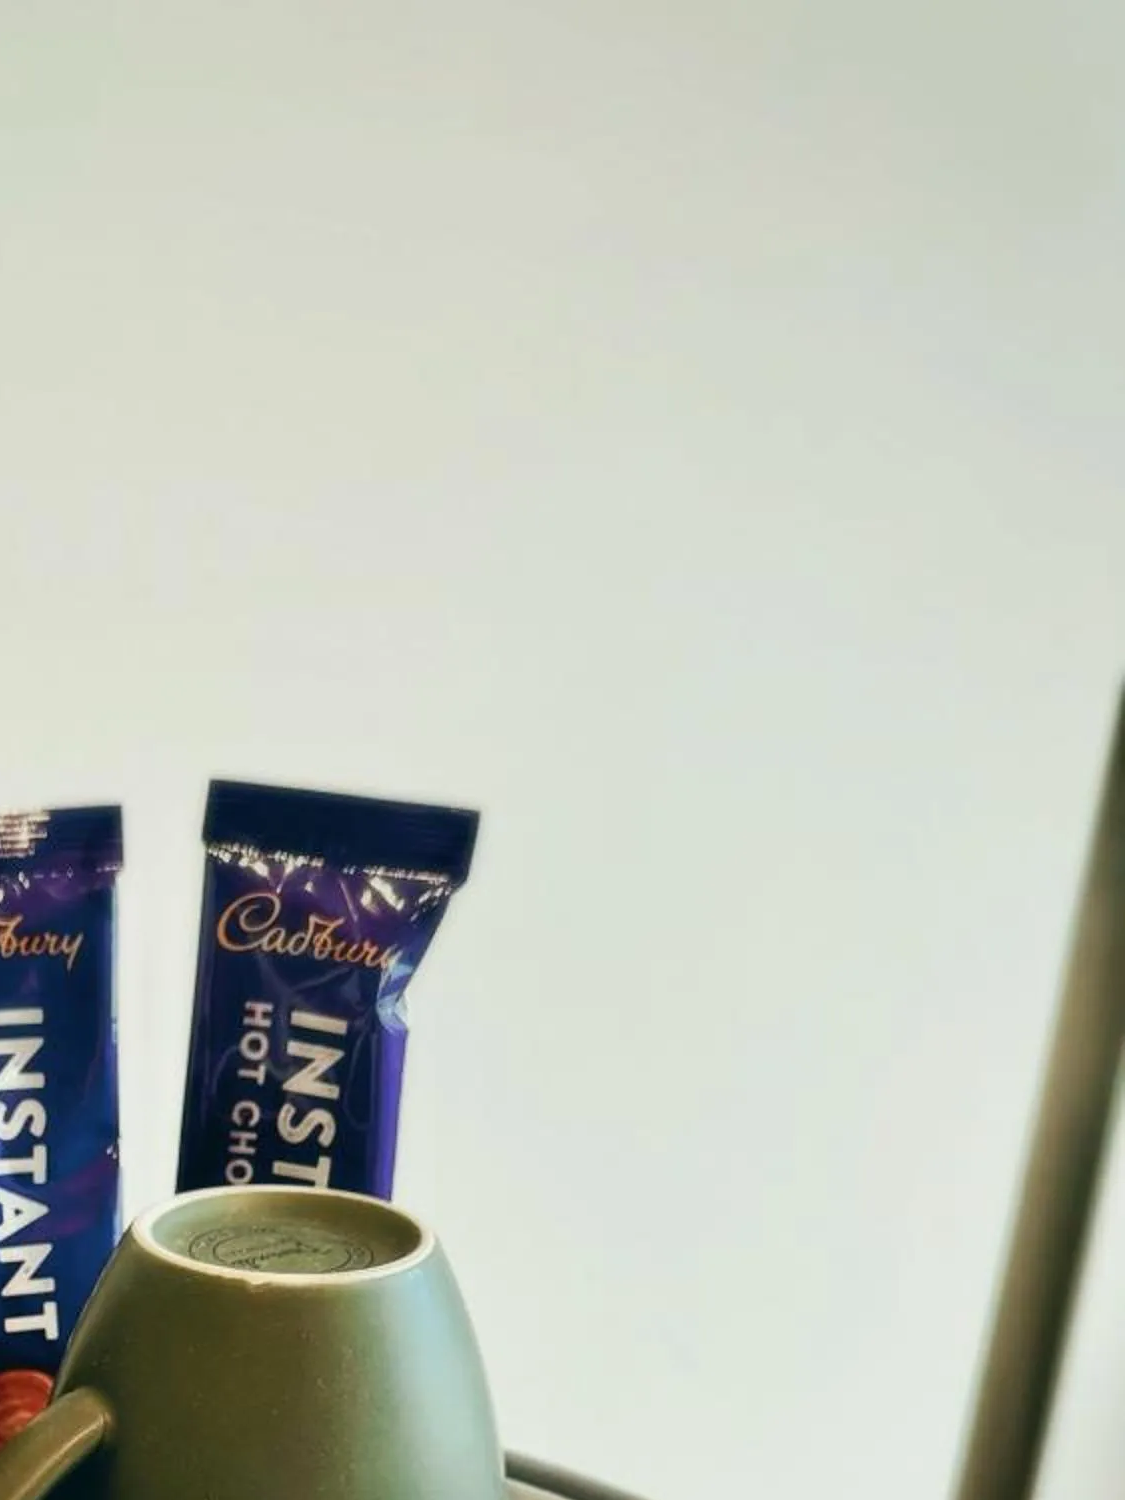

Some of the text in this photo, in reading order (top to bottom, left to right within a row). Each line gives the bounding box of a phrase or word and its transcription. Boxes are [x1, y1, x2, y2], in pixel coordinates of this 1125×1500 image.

[217, 893, 403, 971] Cadbury
[224, 1000, 274, 1185] HOT CHO
[271, 1009, 349, 1189] INST
